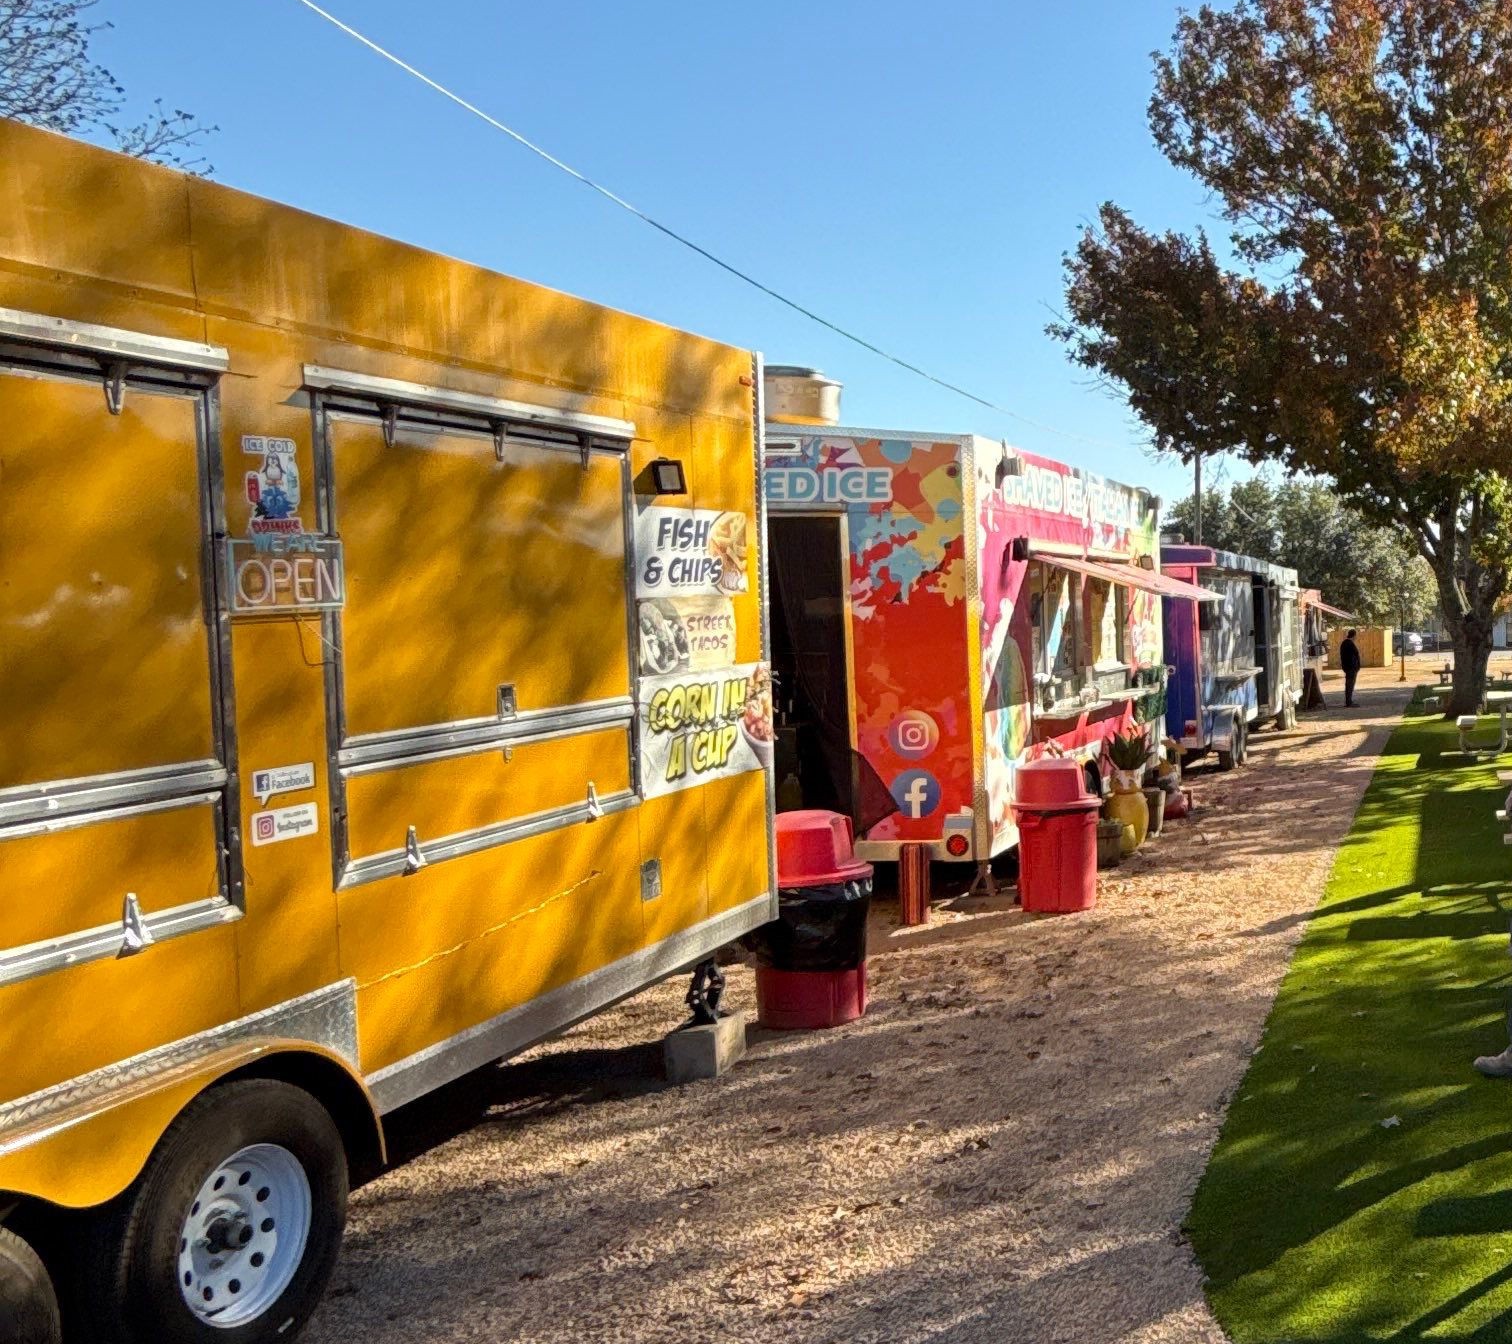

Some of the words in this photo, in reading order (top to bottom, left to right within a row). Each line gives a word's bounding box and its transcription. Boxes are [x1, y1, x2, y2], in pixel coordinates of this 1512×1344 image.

[244, 438, 263, 452] ICE
[267, 439, 295, 454] COLD
[823, 468, 893, 502] ICE
[1004, 465, 1063, 514] SHAVED
[254, 534, 284, 553] WE
[287, 534, 326, 553] ARE
[657, 517, 711, 551] FISH
[237, 558, 340, 604] OPEN
[644, 556, 663, 586] &
[668, 557, 723, 586] CHIPS
[687, 614, 733, 632] STREET
[691, 635, 729, 651] TACOS
[649, 681, 718, 734] CORN
[722, 677, 748, 720] IN
[666, 733, 687, 783] A
[691, 724, 738, 774] CUP
[272, 772, 311, 789] Facebook
